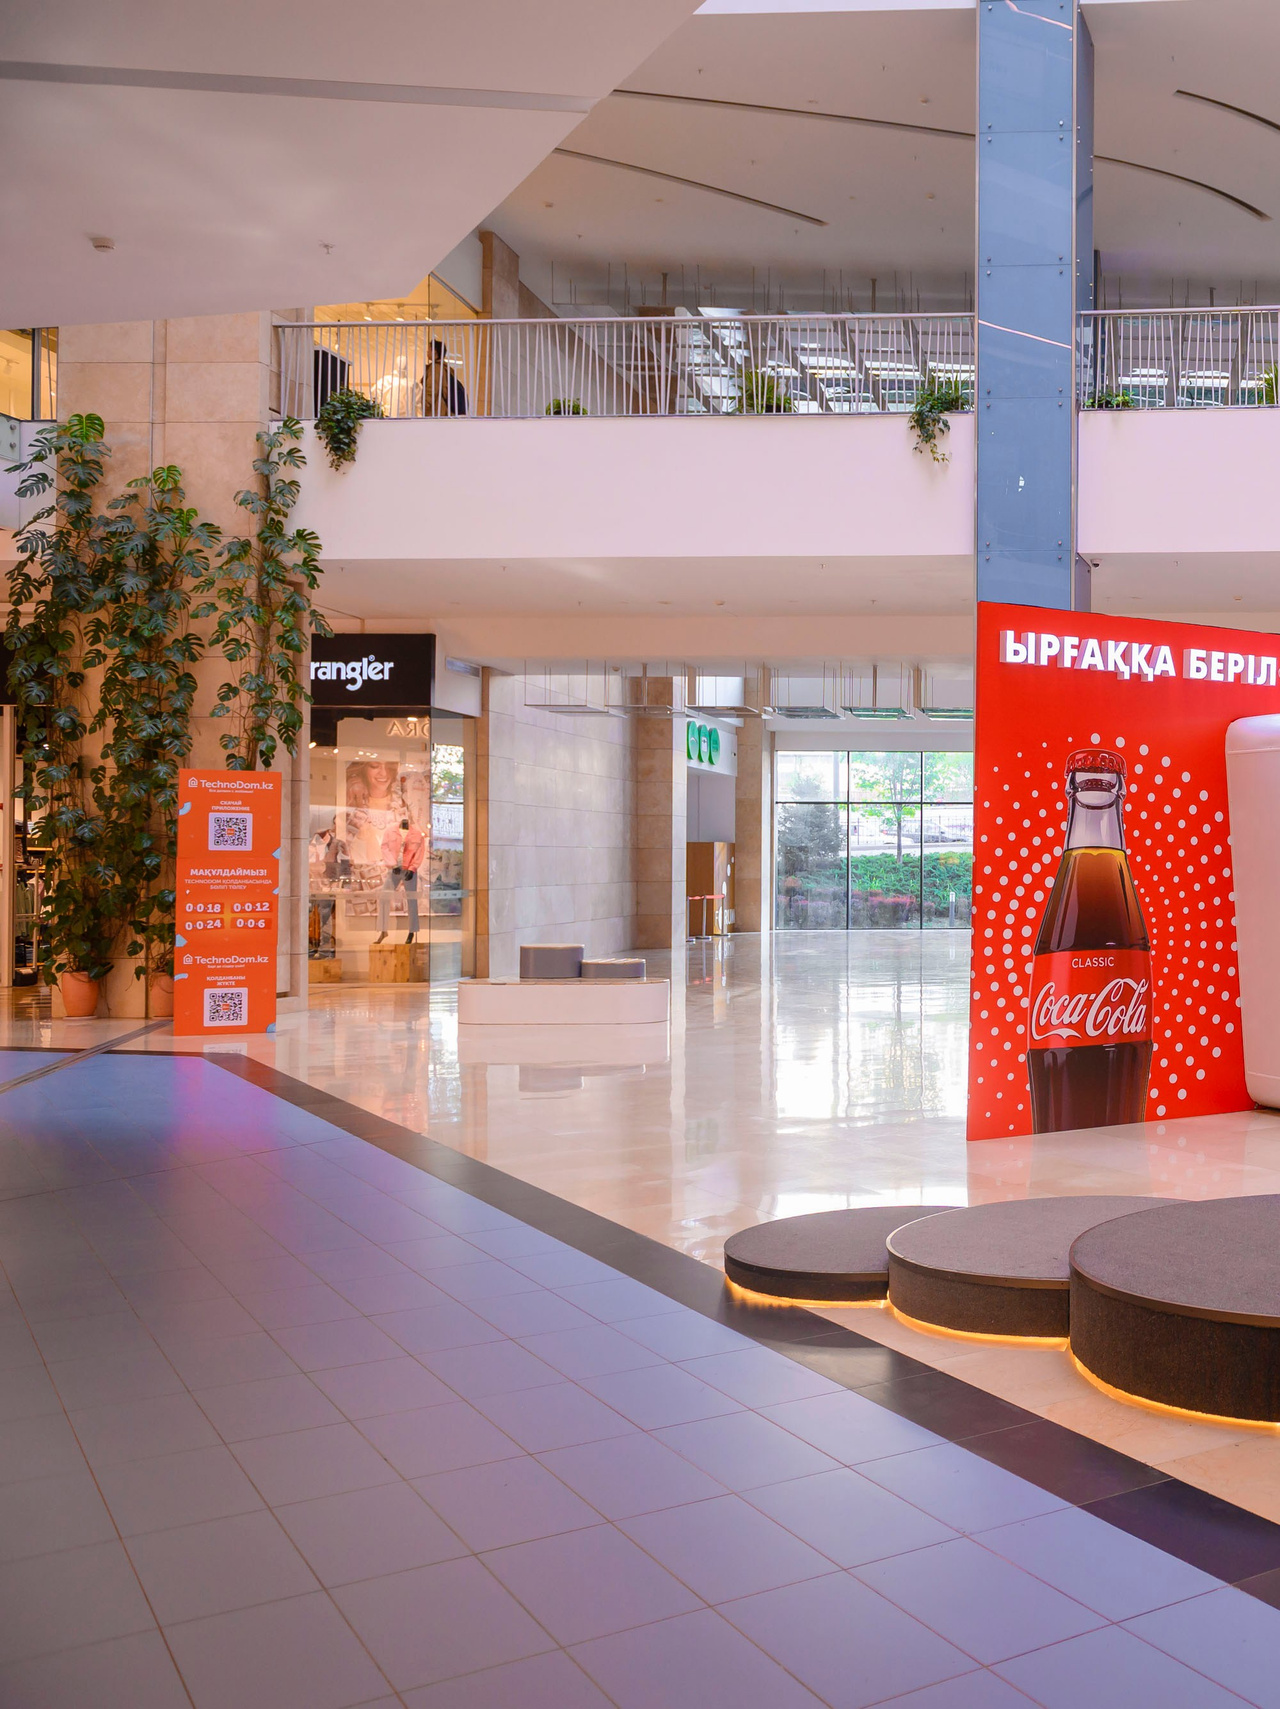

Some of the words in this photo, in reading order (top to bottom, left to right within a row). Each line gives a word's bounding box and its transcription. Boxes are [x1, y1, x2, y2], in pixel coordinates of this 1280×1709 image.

[1003, 629, 1176, 683] ЫРҒАҚҚА
[310, 655, 395, 692] rangler
[200, 779, 274, 790] TechnoDom.kz
[194, 954, 269, 964] TechnoDom.kz
[1071, 956, 1115, 969] CLASSIC
[1032, 977, 1149, 1042] Coca-Cola
